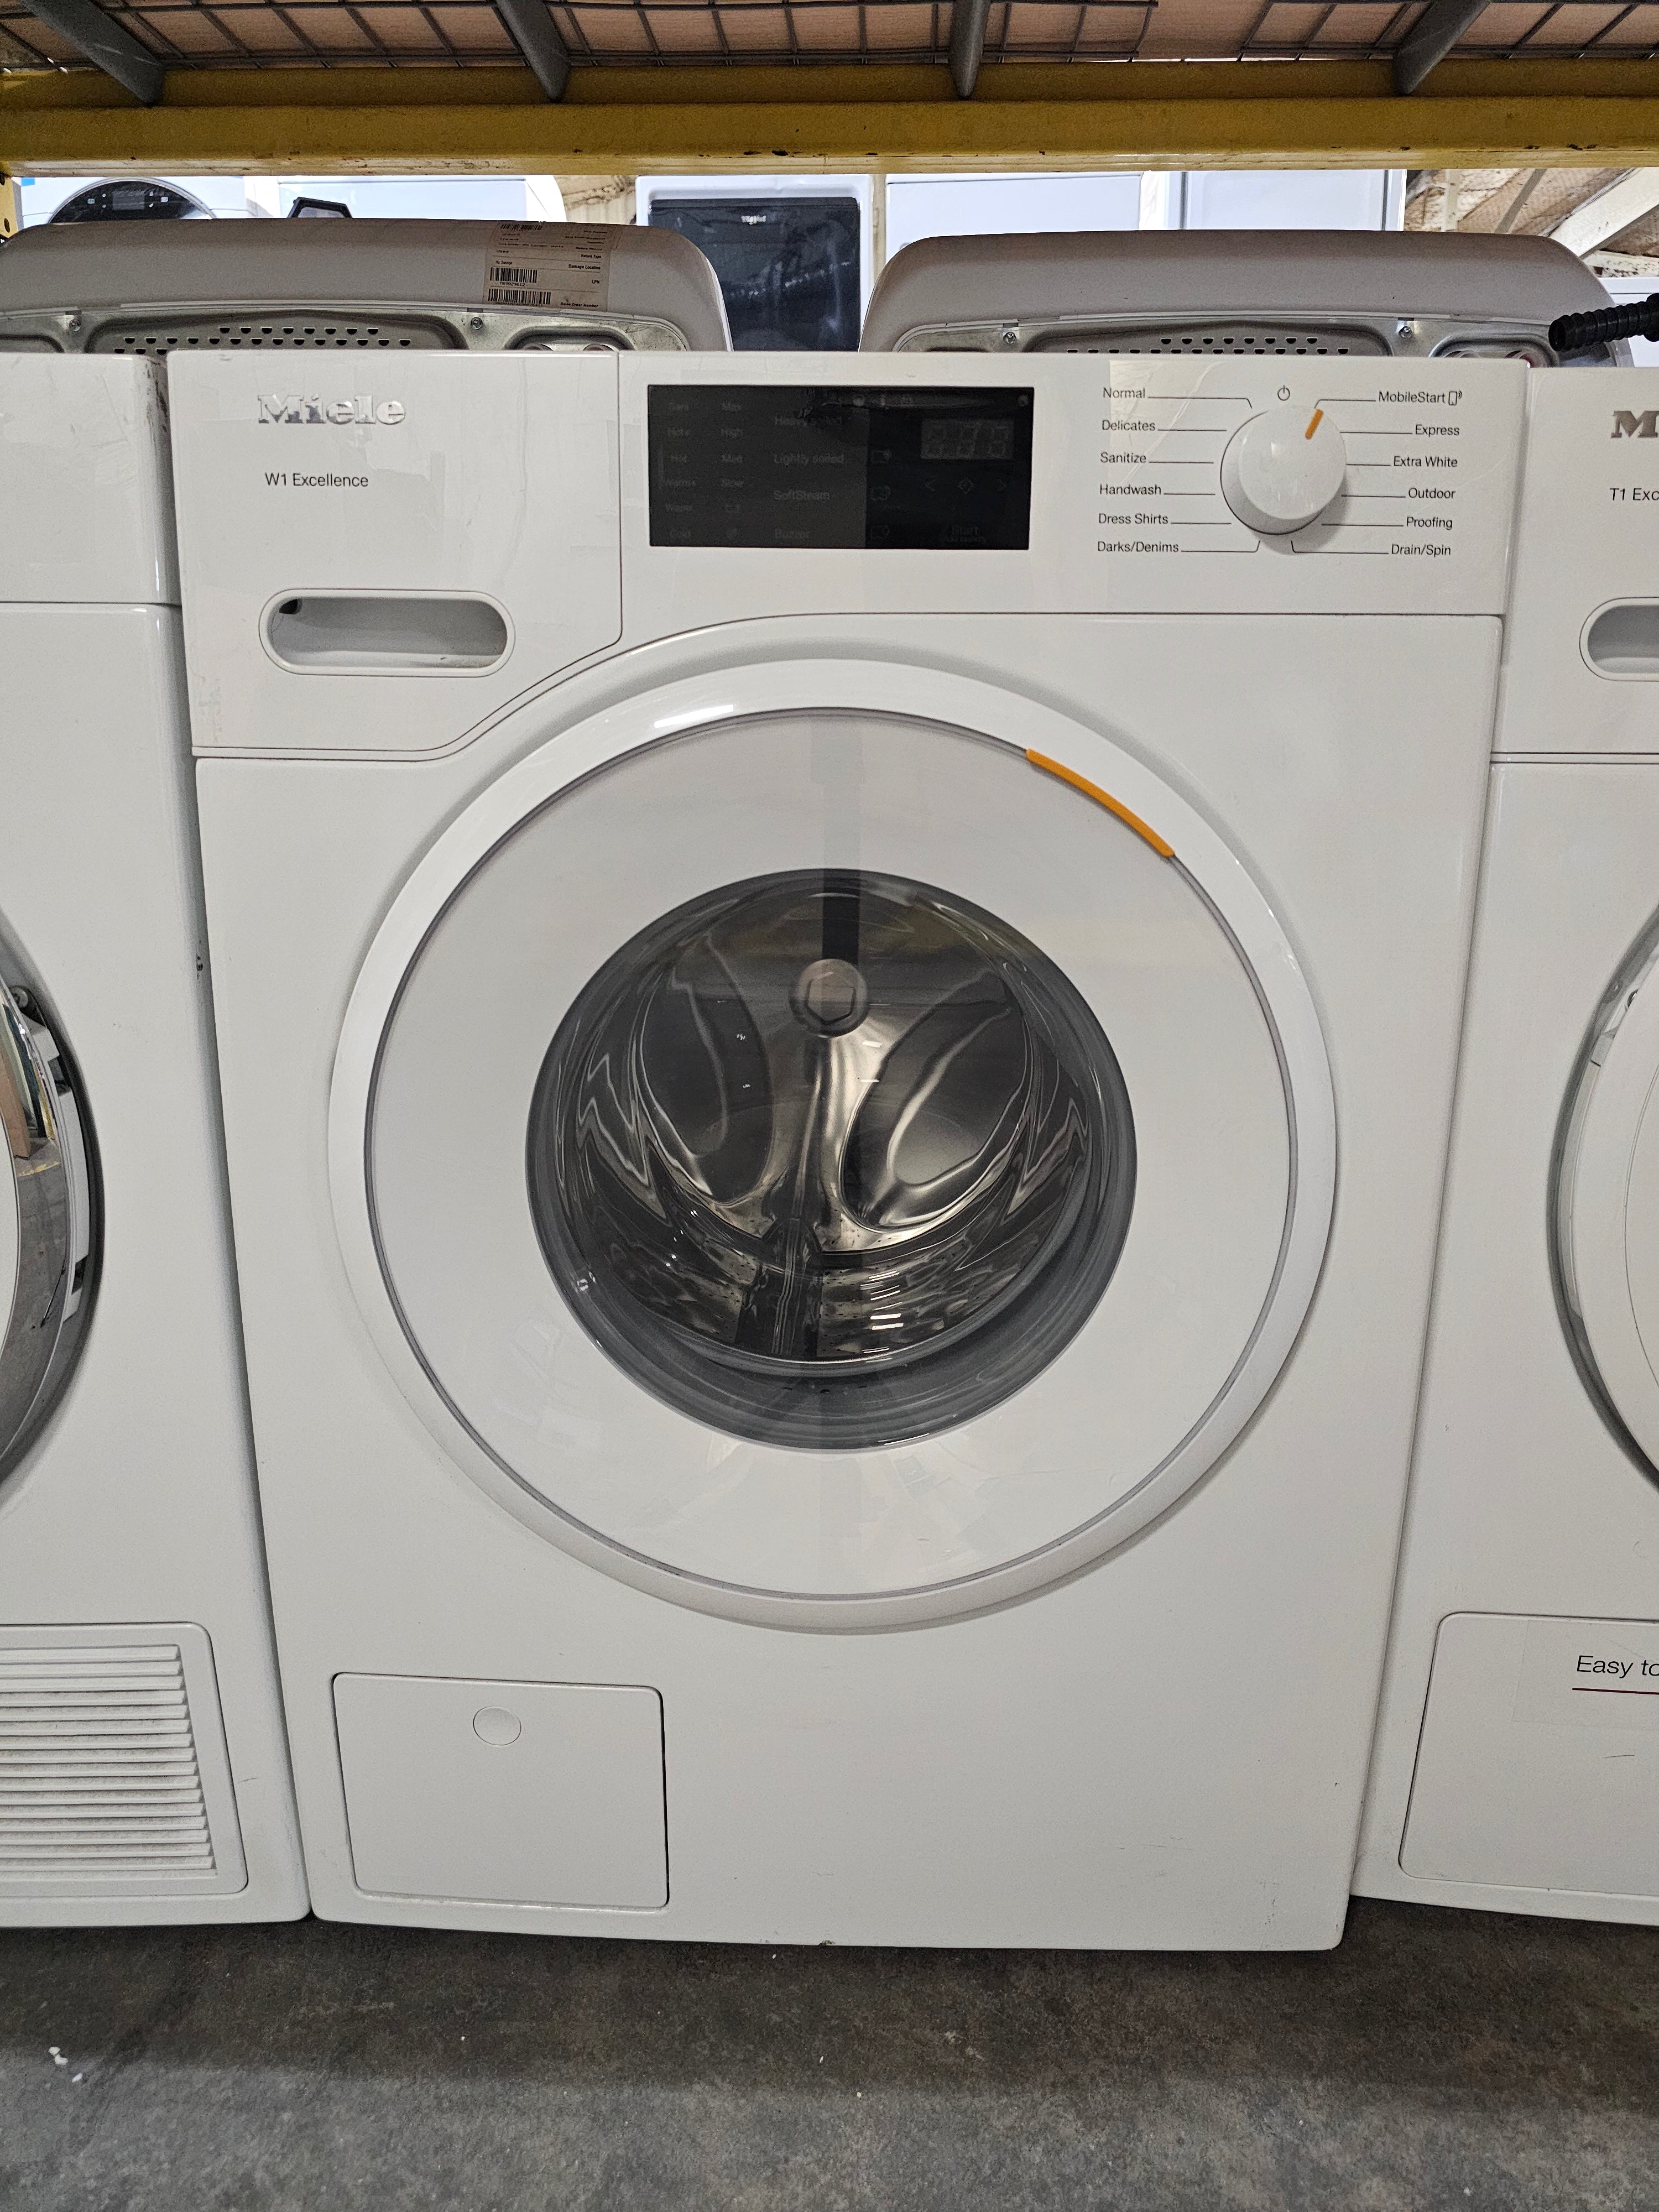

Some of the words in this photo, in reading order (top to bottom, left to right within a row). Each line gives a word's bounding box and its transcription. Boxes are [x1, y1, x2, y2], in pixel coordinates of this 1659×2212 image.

[1103, 387, 1145, 399] Normal
[1379, 391, 1446, 404] MobileStart
[257, 393, 406, 425] Miele
[1102, 419, 1156, 431] Delicates
[1415, 424, 1460, 437] Express
[1100, 451, 1146, 463] Sanitize
[1393, 455, 1422, 467] Extra
[1425, 456, 1458, 468] White
[264, 472, 286, 486] W1
[293, 473, 369, 487] Excellence
[1099, 484, 1162, 495] Handwash
[1408, 487, 1456, 499] Outdoor
[1609, 487, 1625, 501] T1
[1098, 513, 1131, 524] Dress
[1134, 513, 1168, 525] Shirts
[1406, 516, 1453, 531] Proofing
[1097, 541, 1179, 553] Darks/Denims
[1391, 544, 1451, 558] Drain/Spin
[1576, 1655, 1634, 1679] Easy
